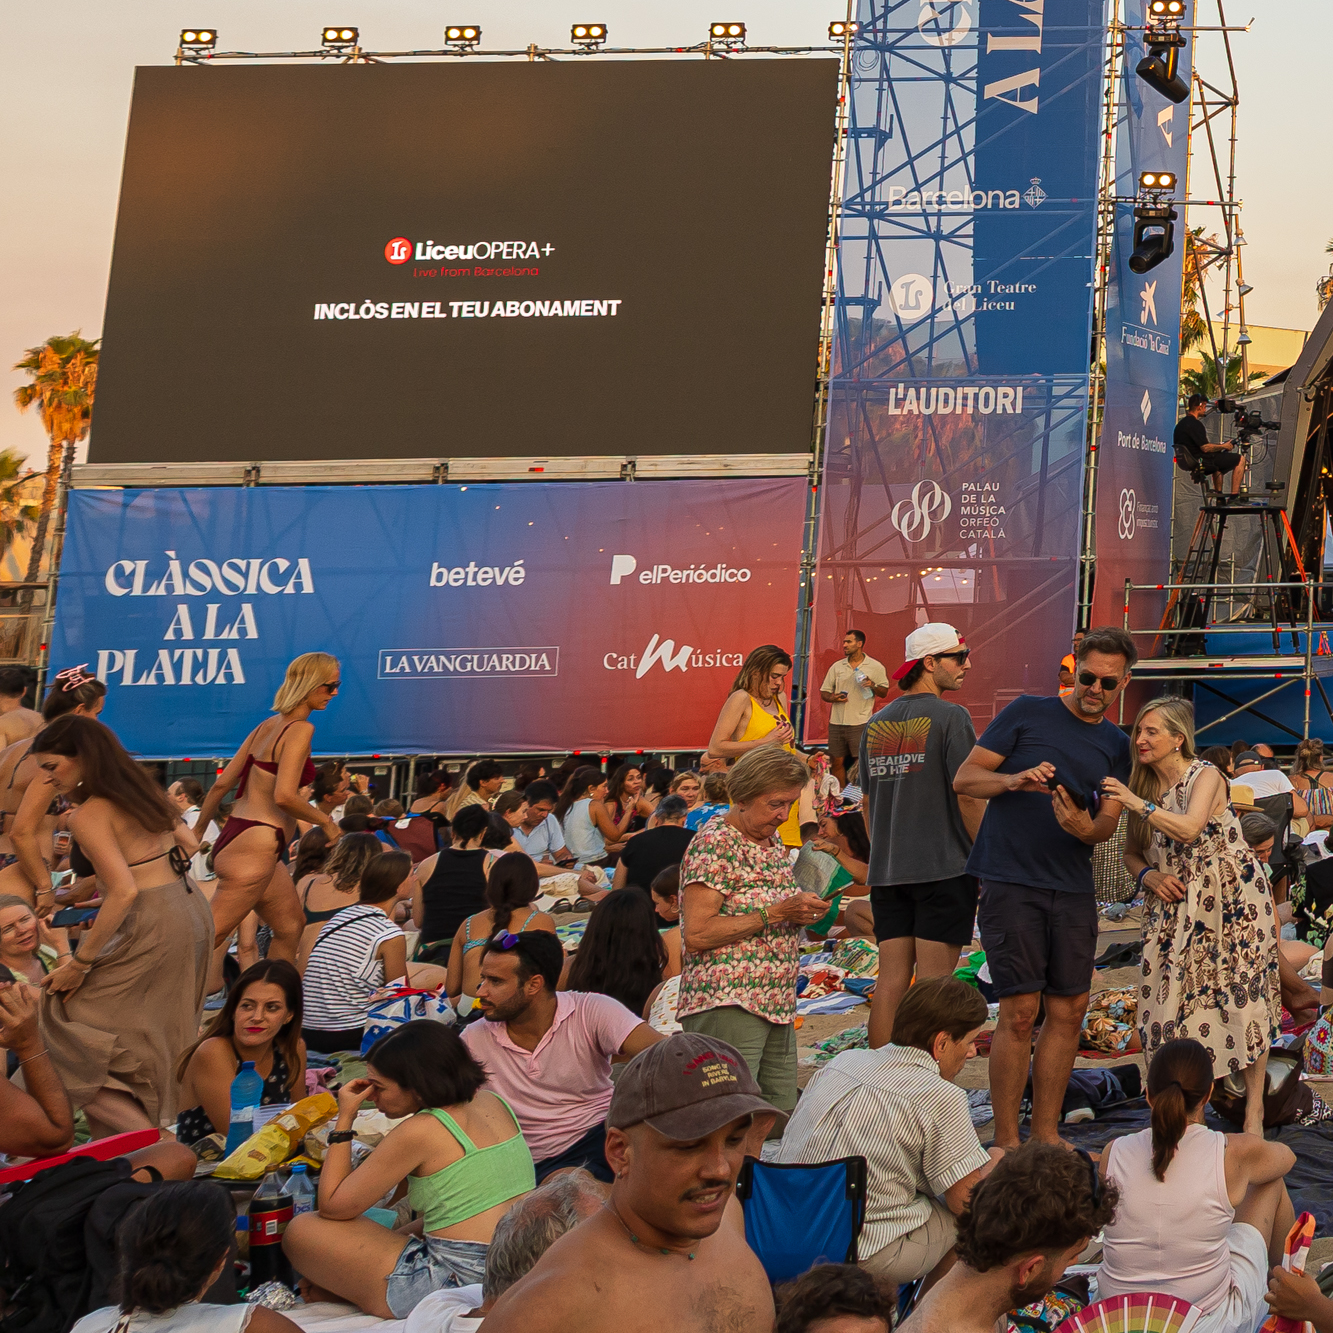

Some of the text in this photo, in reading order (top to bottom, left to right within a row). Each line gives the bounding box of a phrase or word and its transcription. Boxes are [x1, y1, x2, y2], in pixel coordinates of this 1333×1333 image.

[983, 68, 1041, 114] A
[887, 185, 1019, 211] Barcelona
[413, 266, 539, 277] Live from Barcelona
[943, 280, 1037, 294] Gran Teatre
[314, 299, 622, 319] INCLÒS EN EL TEU ABONAMENT
[972, 298, 1015, 311] Liceu
[888, 383, 1023, 416] L'AUDITORI
[1118, 431, 1166, 453] Port de Barcelona
[962, 482, 999, 491] PALAU
[962, 494, 996, 503] DE LA
[961, 504, 1006, 515] MÚSICA
[960, 516, 999, 527] ORFEÓ
[960, 528, 1006, 539] CATALÀ
[105, 550, 315, 597] CLÀSSICA
[430, 559, 526, 587] betevé
[639, 564, 751, 585] elPeriódico
[163, 603, 259, 641] A LA
[97, 648, 246, 686] PLATJA
[384, 652, 551, 673] LA VANGUARDIA
